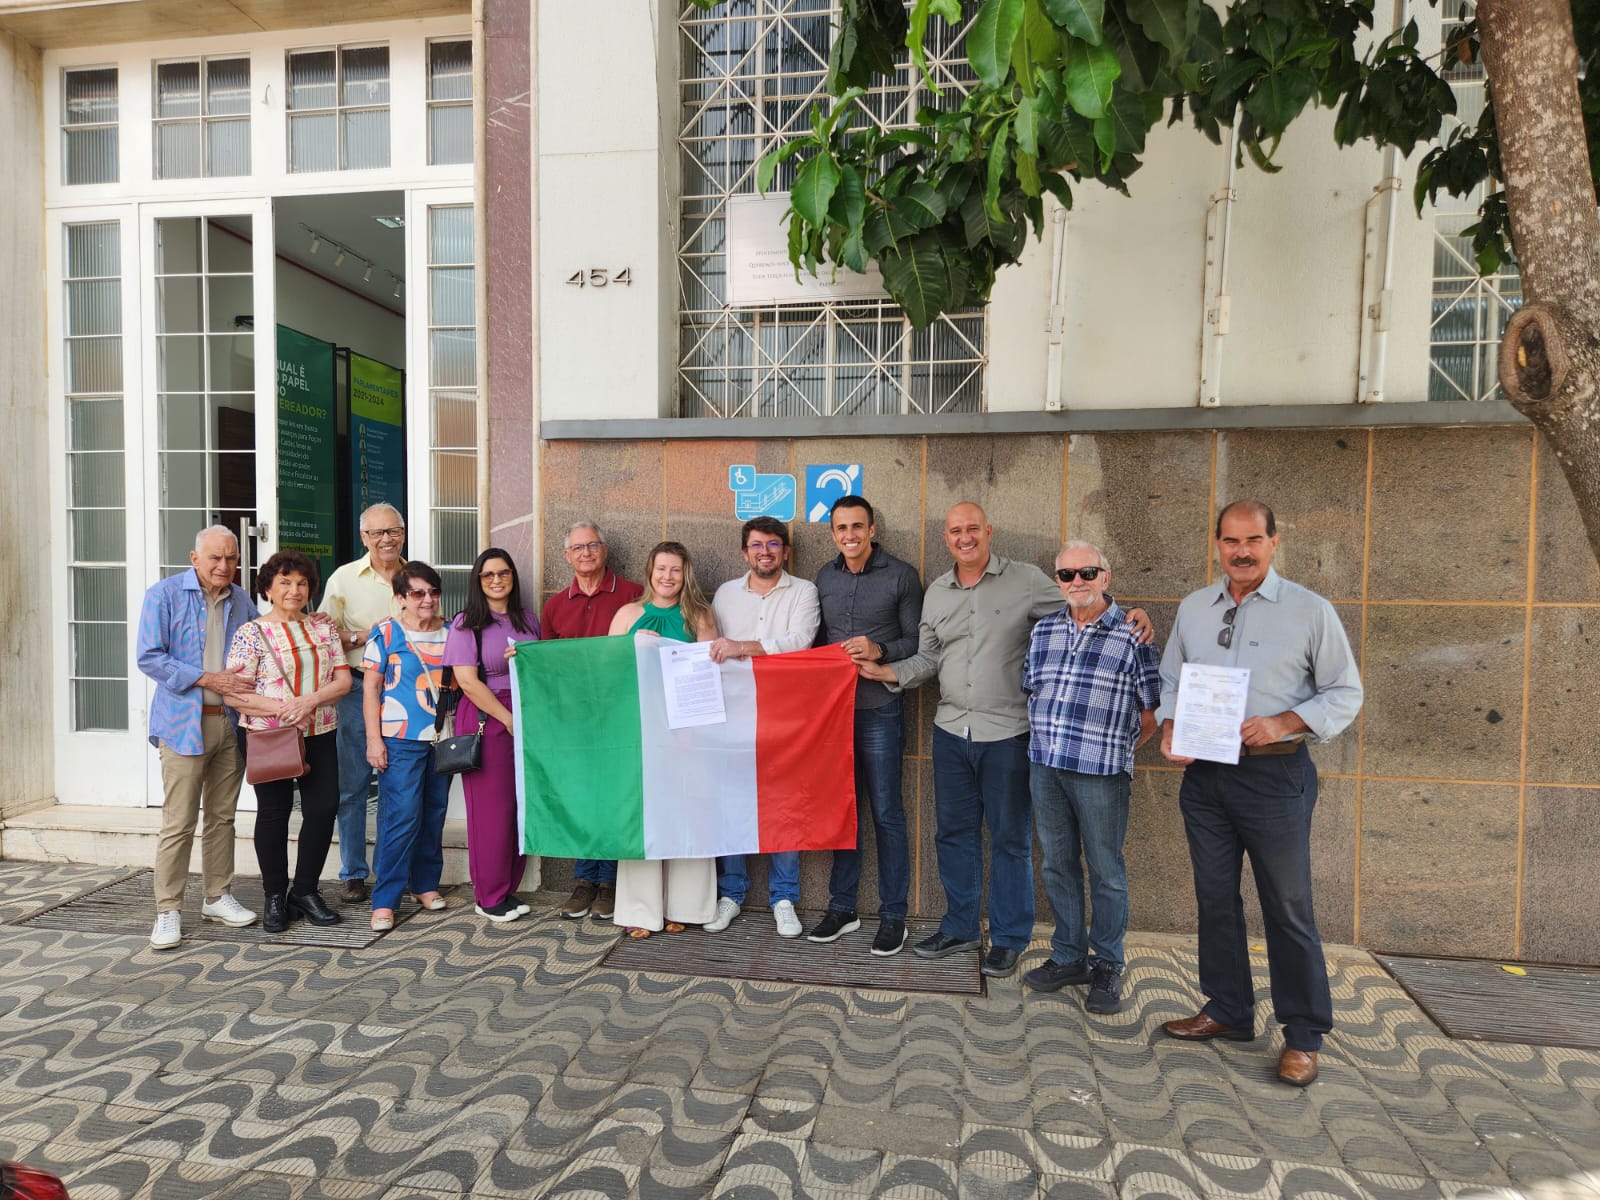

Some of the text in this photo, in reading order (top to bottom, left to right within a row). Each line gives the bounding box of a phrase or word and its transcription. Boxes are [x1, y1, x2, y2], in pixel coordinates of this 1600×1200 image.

[565, 266, 632, 288] 454
[300, 363, 305, 378] É
[277, 384, 286, 397] O
[281, 373, 310, 392] PAPEL
[353, 388, 385, 406] 2021-2024
[279, 398, 328, 420] EREADOR?
